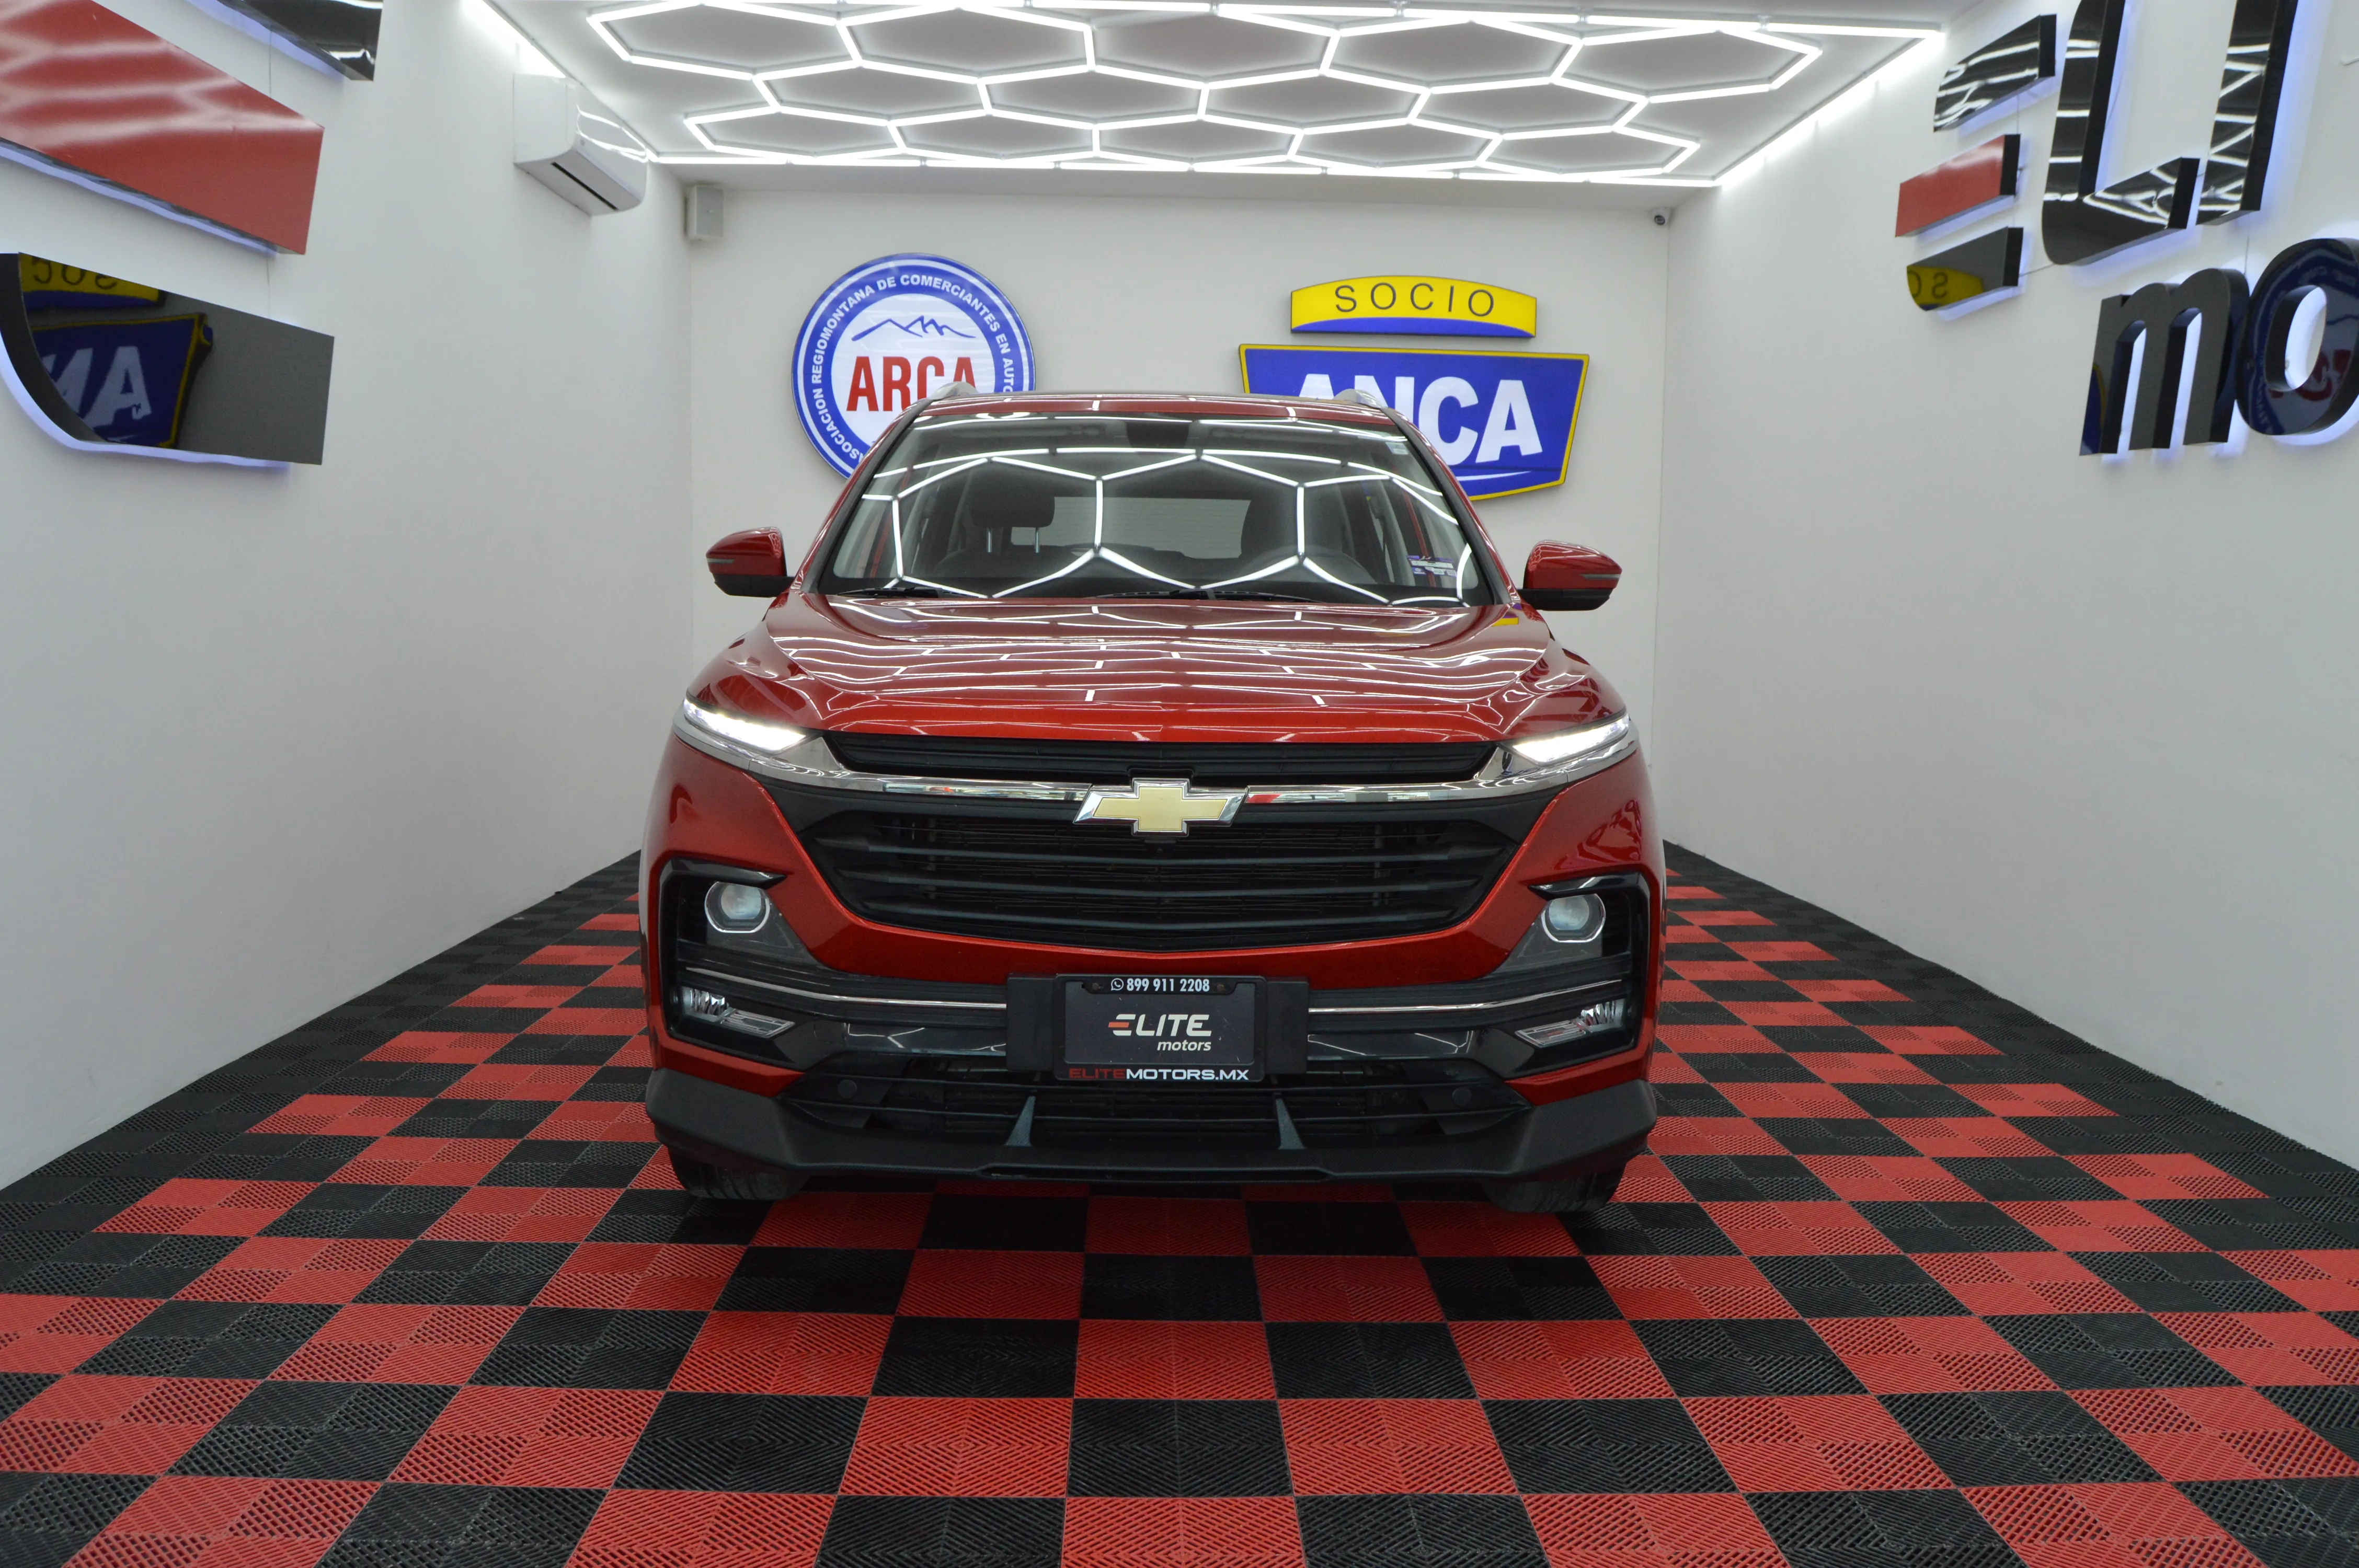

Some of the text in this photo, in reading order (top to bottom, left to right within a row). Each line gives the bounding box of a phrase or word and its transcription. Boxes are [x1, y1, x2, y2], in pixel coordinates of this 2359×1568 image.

[1334, 282, 1494, 317] SOCIO
[811, 285, 875, 384] REGIOMONTANA
[876, 276, 896, 291] DE
[900, 274, 1000, 332] COMERCIANTES
[995, 333, 1011, 354] EN
[1127, 978, 1210, 992] 899 911 2208
[1108, 1013, 1212, 1037] ELITE
[1157, 1040, 1211, 1051] motors
[1069, 1068, 1249, 1080] ELITEMOTORS.MX
